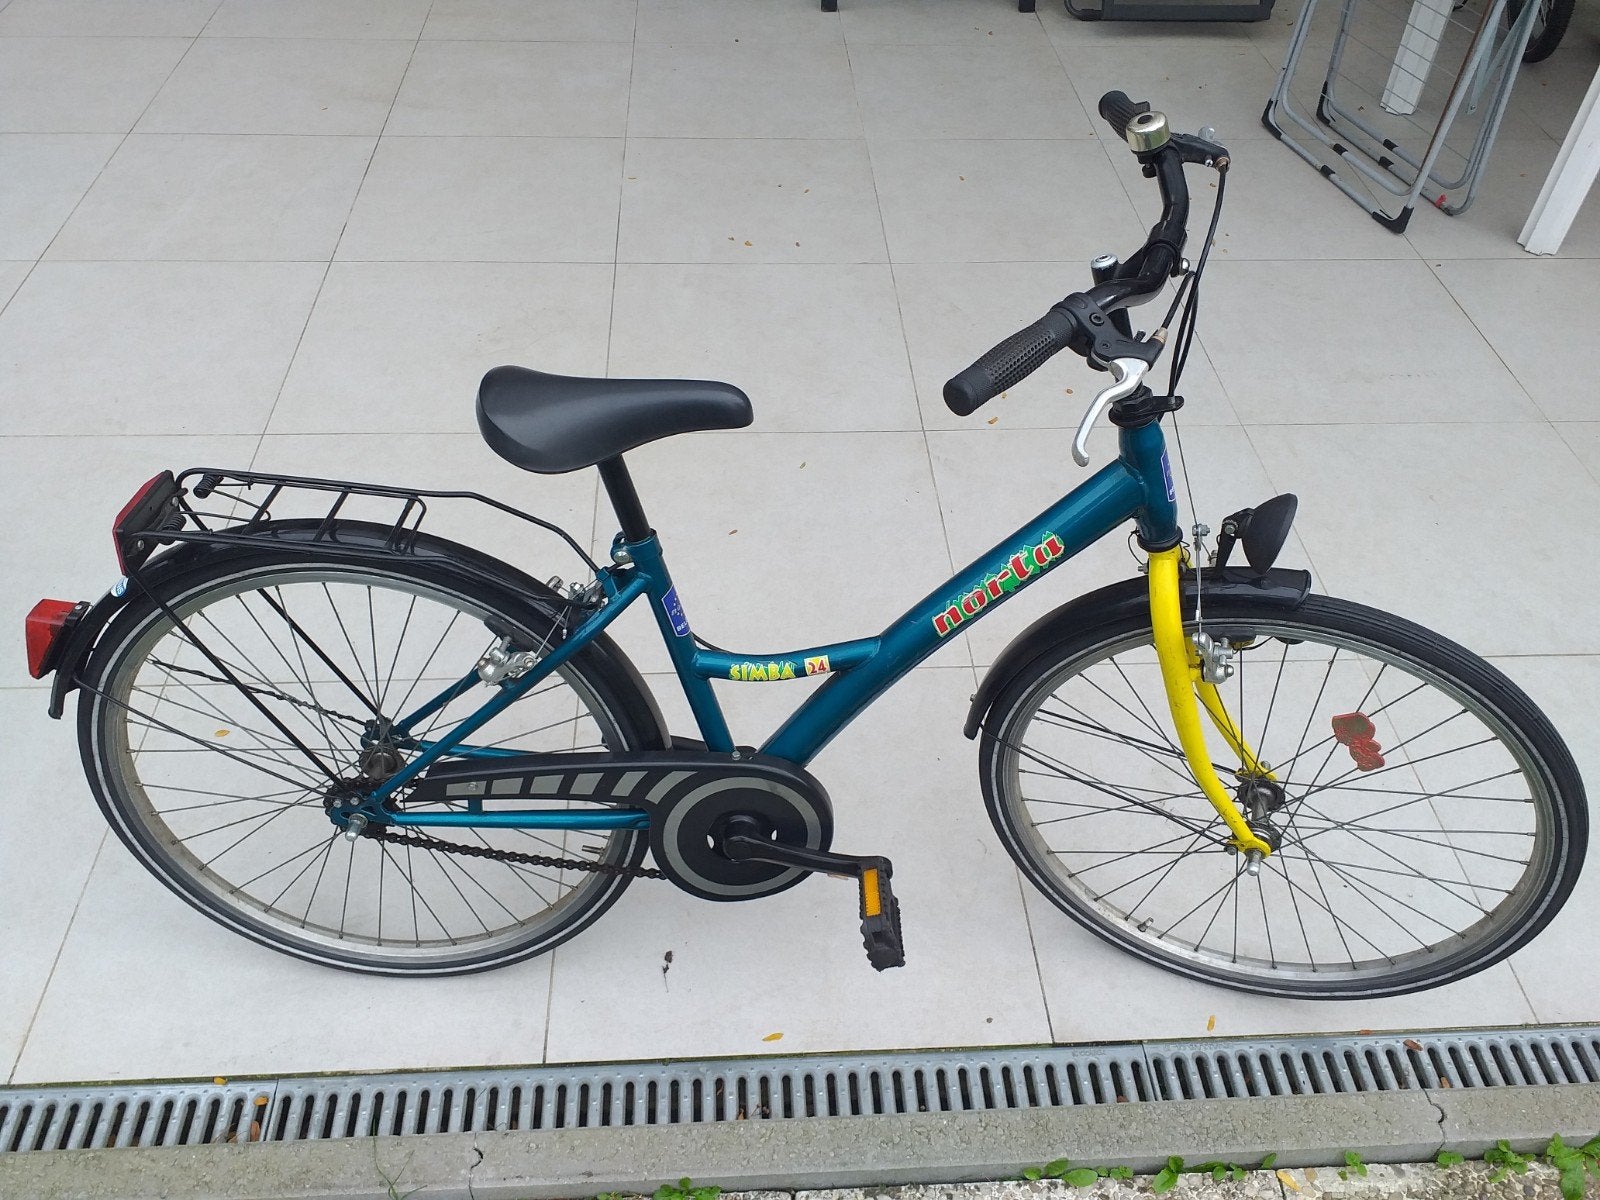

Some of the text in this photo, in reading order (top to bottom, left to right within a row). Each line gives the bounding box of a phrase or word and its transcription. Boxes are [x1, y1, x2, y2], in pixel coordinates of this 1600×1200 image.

[932, 535, 1065, 636] norta
[730, 659, 827, 681] SIMBA 24
